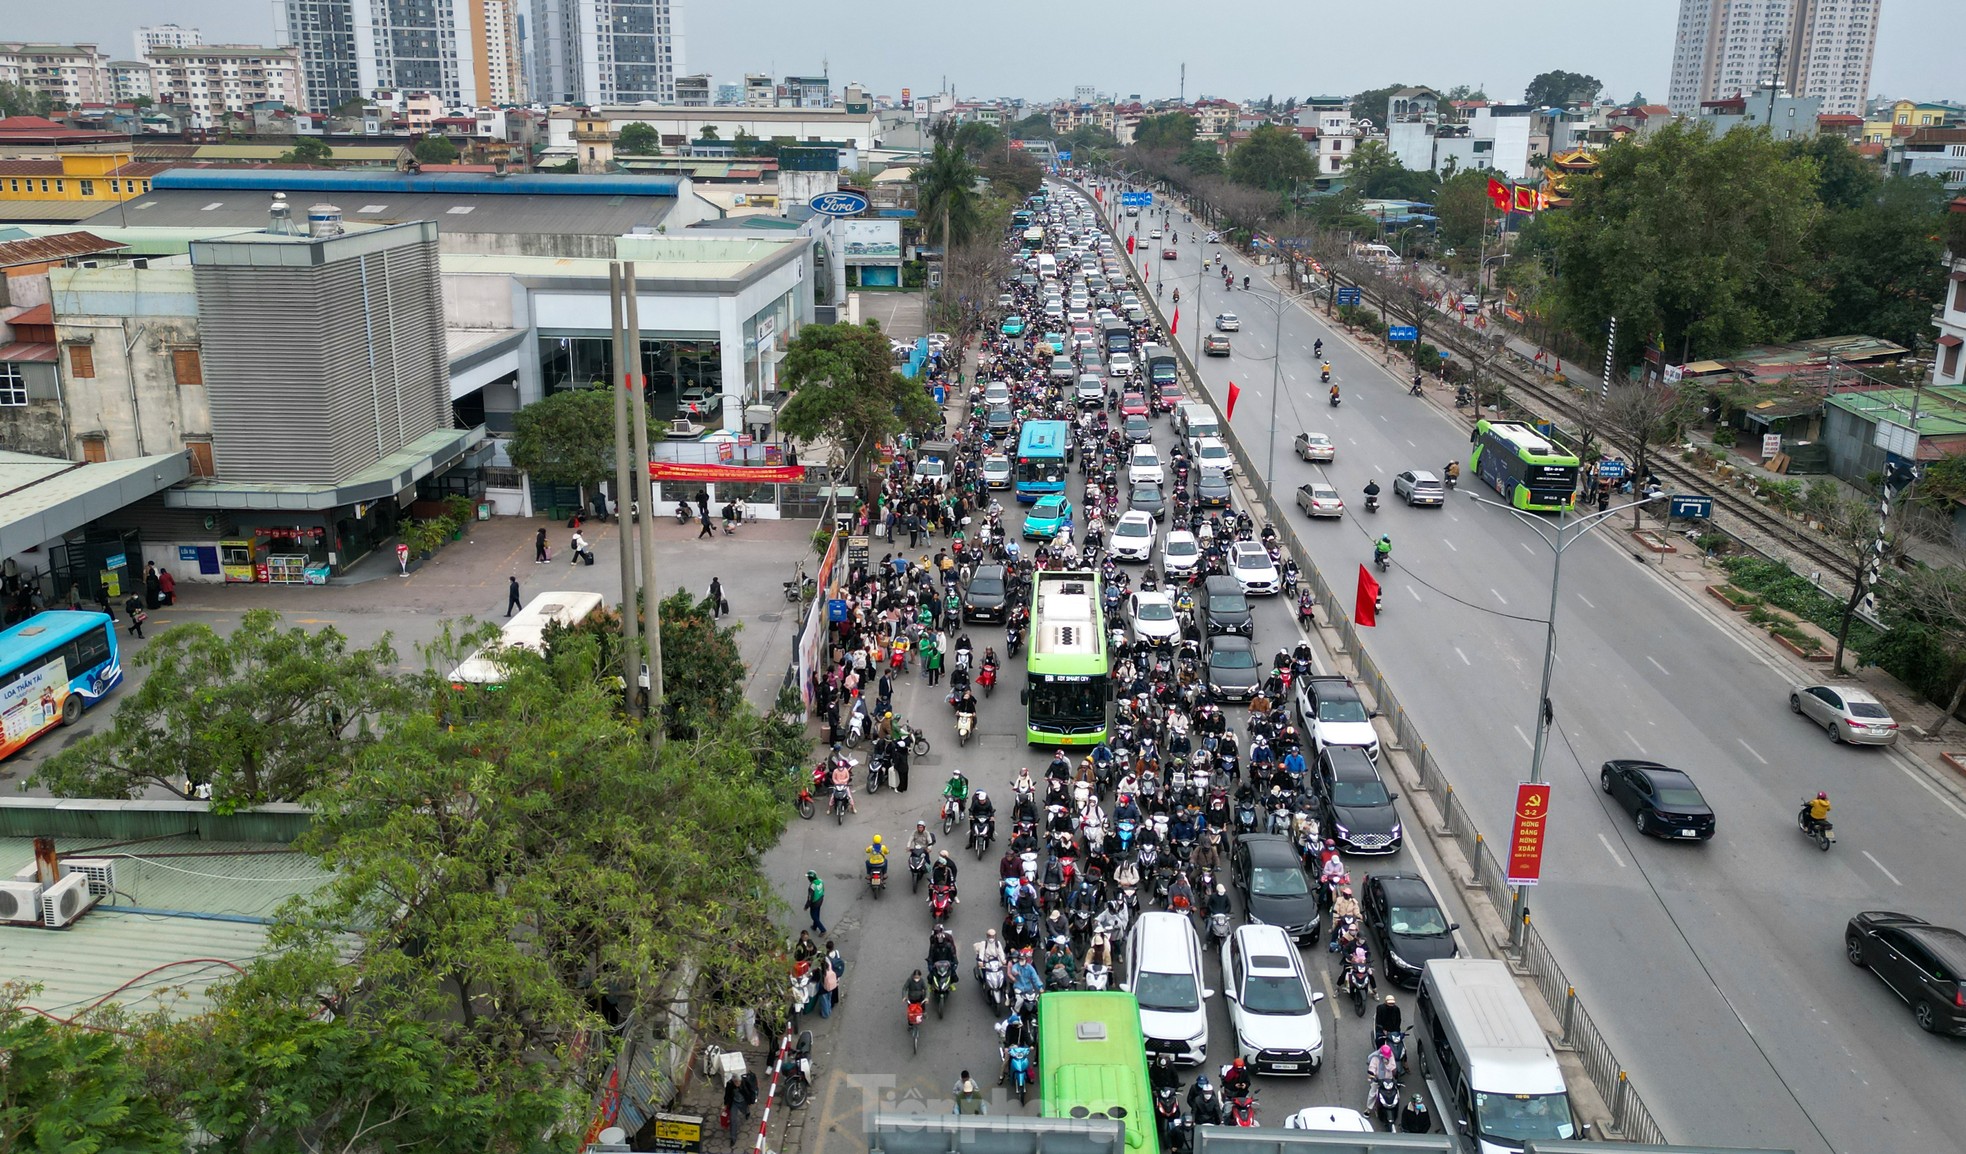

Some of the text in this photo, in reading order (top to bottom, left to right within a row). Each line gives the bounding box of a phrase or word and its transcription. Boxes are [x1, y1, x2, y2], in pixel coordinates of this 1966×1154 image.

[821, 196, 856, 212] Ford
[837, 521, 849, 531] C1
[4, 688, 16, 700] LOA
